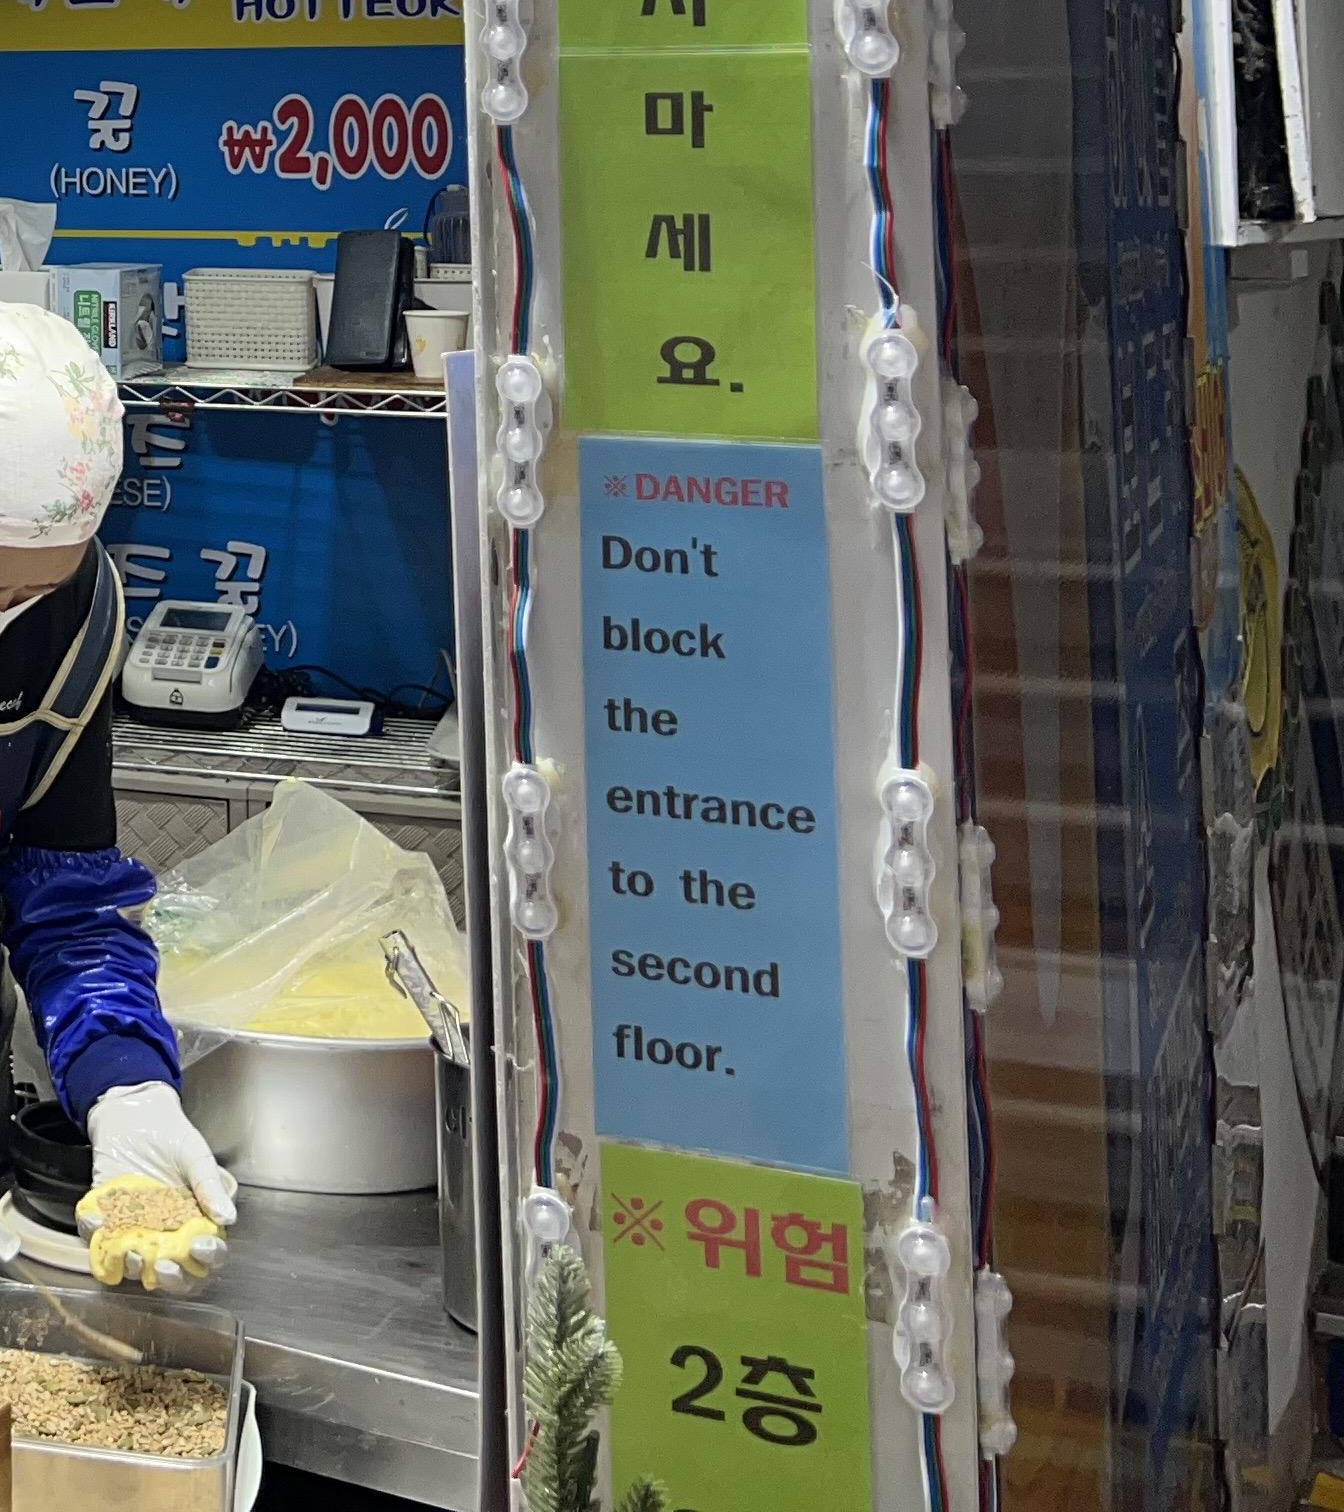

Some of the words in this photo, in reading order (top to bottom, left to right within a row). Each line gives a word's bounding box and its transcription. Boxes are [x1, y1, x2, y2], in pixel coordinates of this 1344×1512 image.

[220, 93, 454, 192] ₩2,000
[50, 163, 179, 198] (HONEY)
[601, 533, 720, 580] Don't
[602, 616, 726, 661] block
[603, 698, 679, 739] the
[605, 780, 817, 835] entrance
[609, 859, 653, 898] to
[679, 868, 756, 912] the
[610, 943, 782, 1000] second
[613, 1023, 737, 1078] floor.
[668, 1343, 824, 1448] 2층
